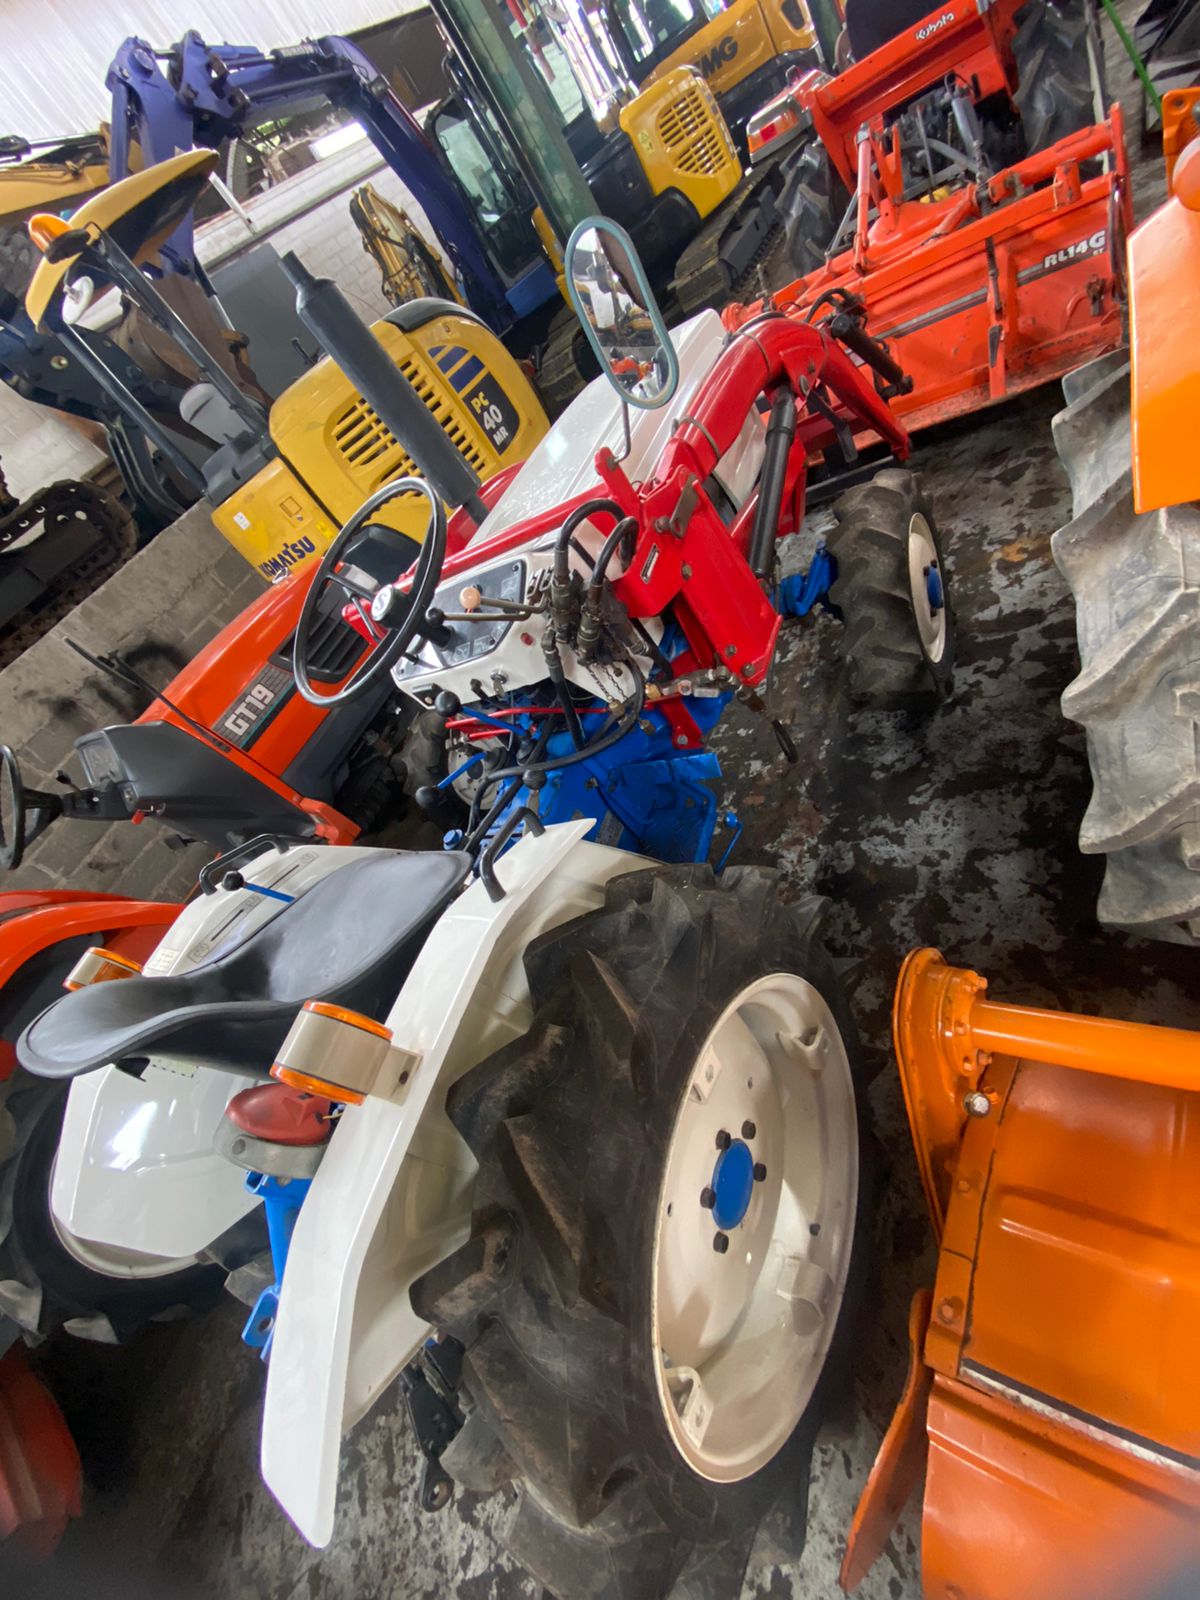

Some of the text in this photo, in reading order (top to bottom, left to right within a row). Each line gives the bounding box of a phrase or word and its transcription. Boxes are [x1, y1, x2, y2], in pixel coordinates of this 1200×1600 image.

[915, 13, 954, 40] Kubota
[694, 35, 738, 79] MG
[1044, 230, 1105, 269] RL14G
[470, 392, 490, 414] PC
[483, 404, 503, 431] 40
[492, 426, 509, 446] MR
[258, 535, 316, 581] KOMATSU
[224, 683, 275, 736] GT19
